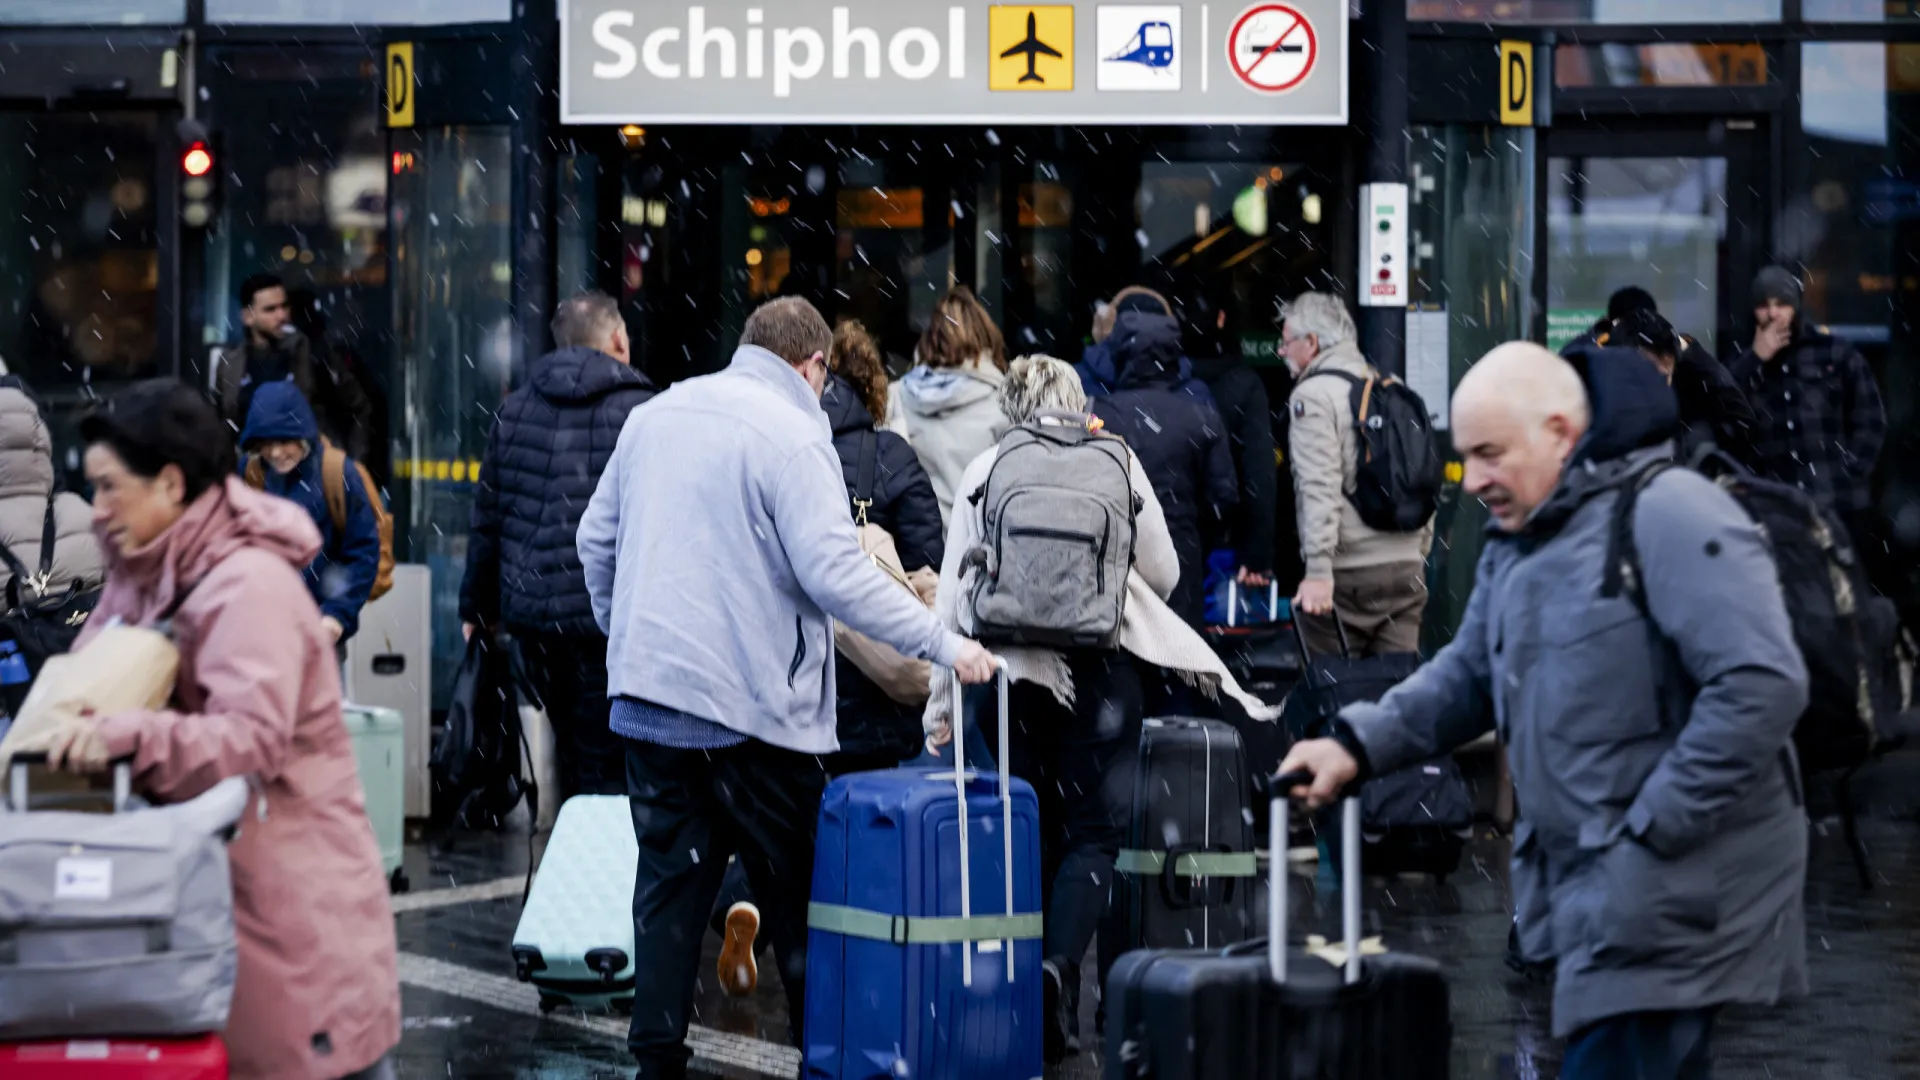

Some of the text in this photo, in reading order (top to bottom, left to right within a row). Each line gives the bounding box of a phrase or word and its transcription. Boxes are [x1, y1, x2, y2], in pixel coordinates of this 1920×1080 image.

[592, 6, 965, 97] Schiphol
[1508, 50, 1527, 112] D
[392, 53, 407, 114] D
